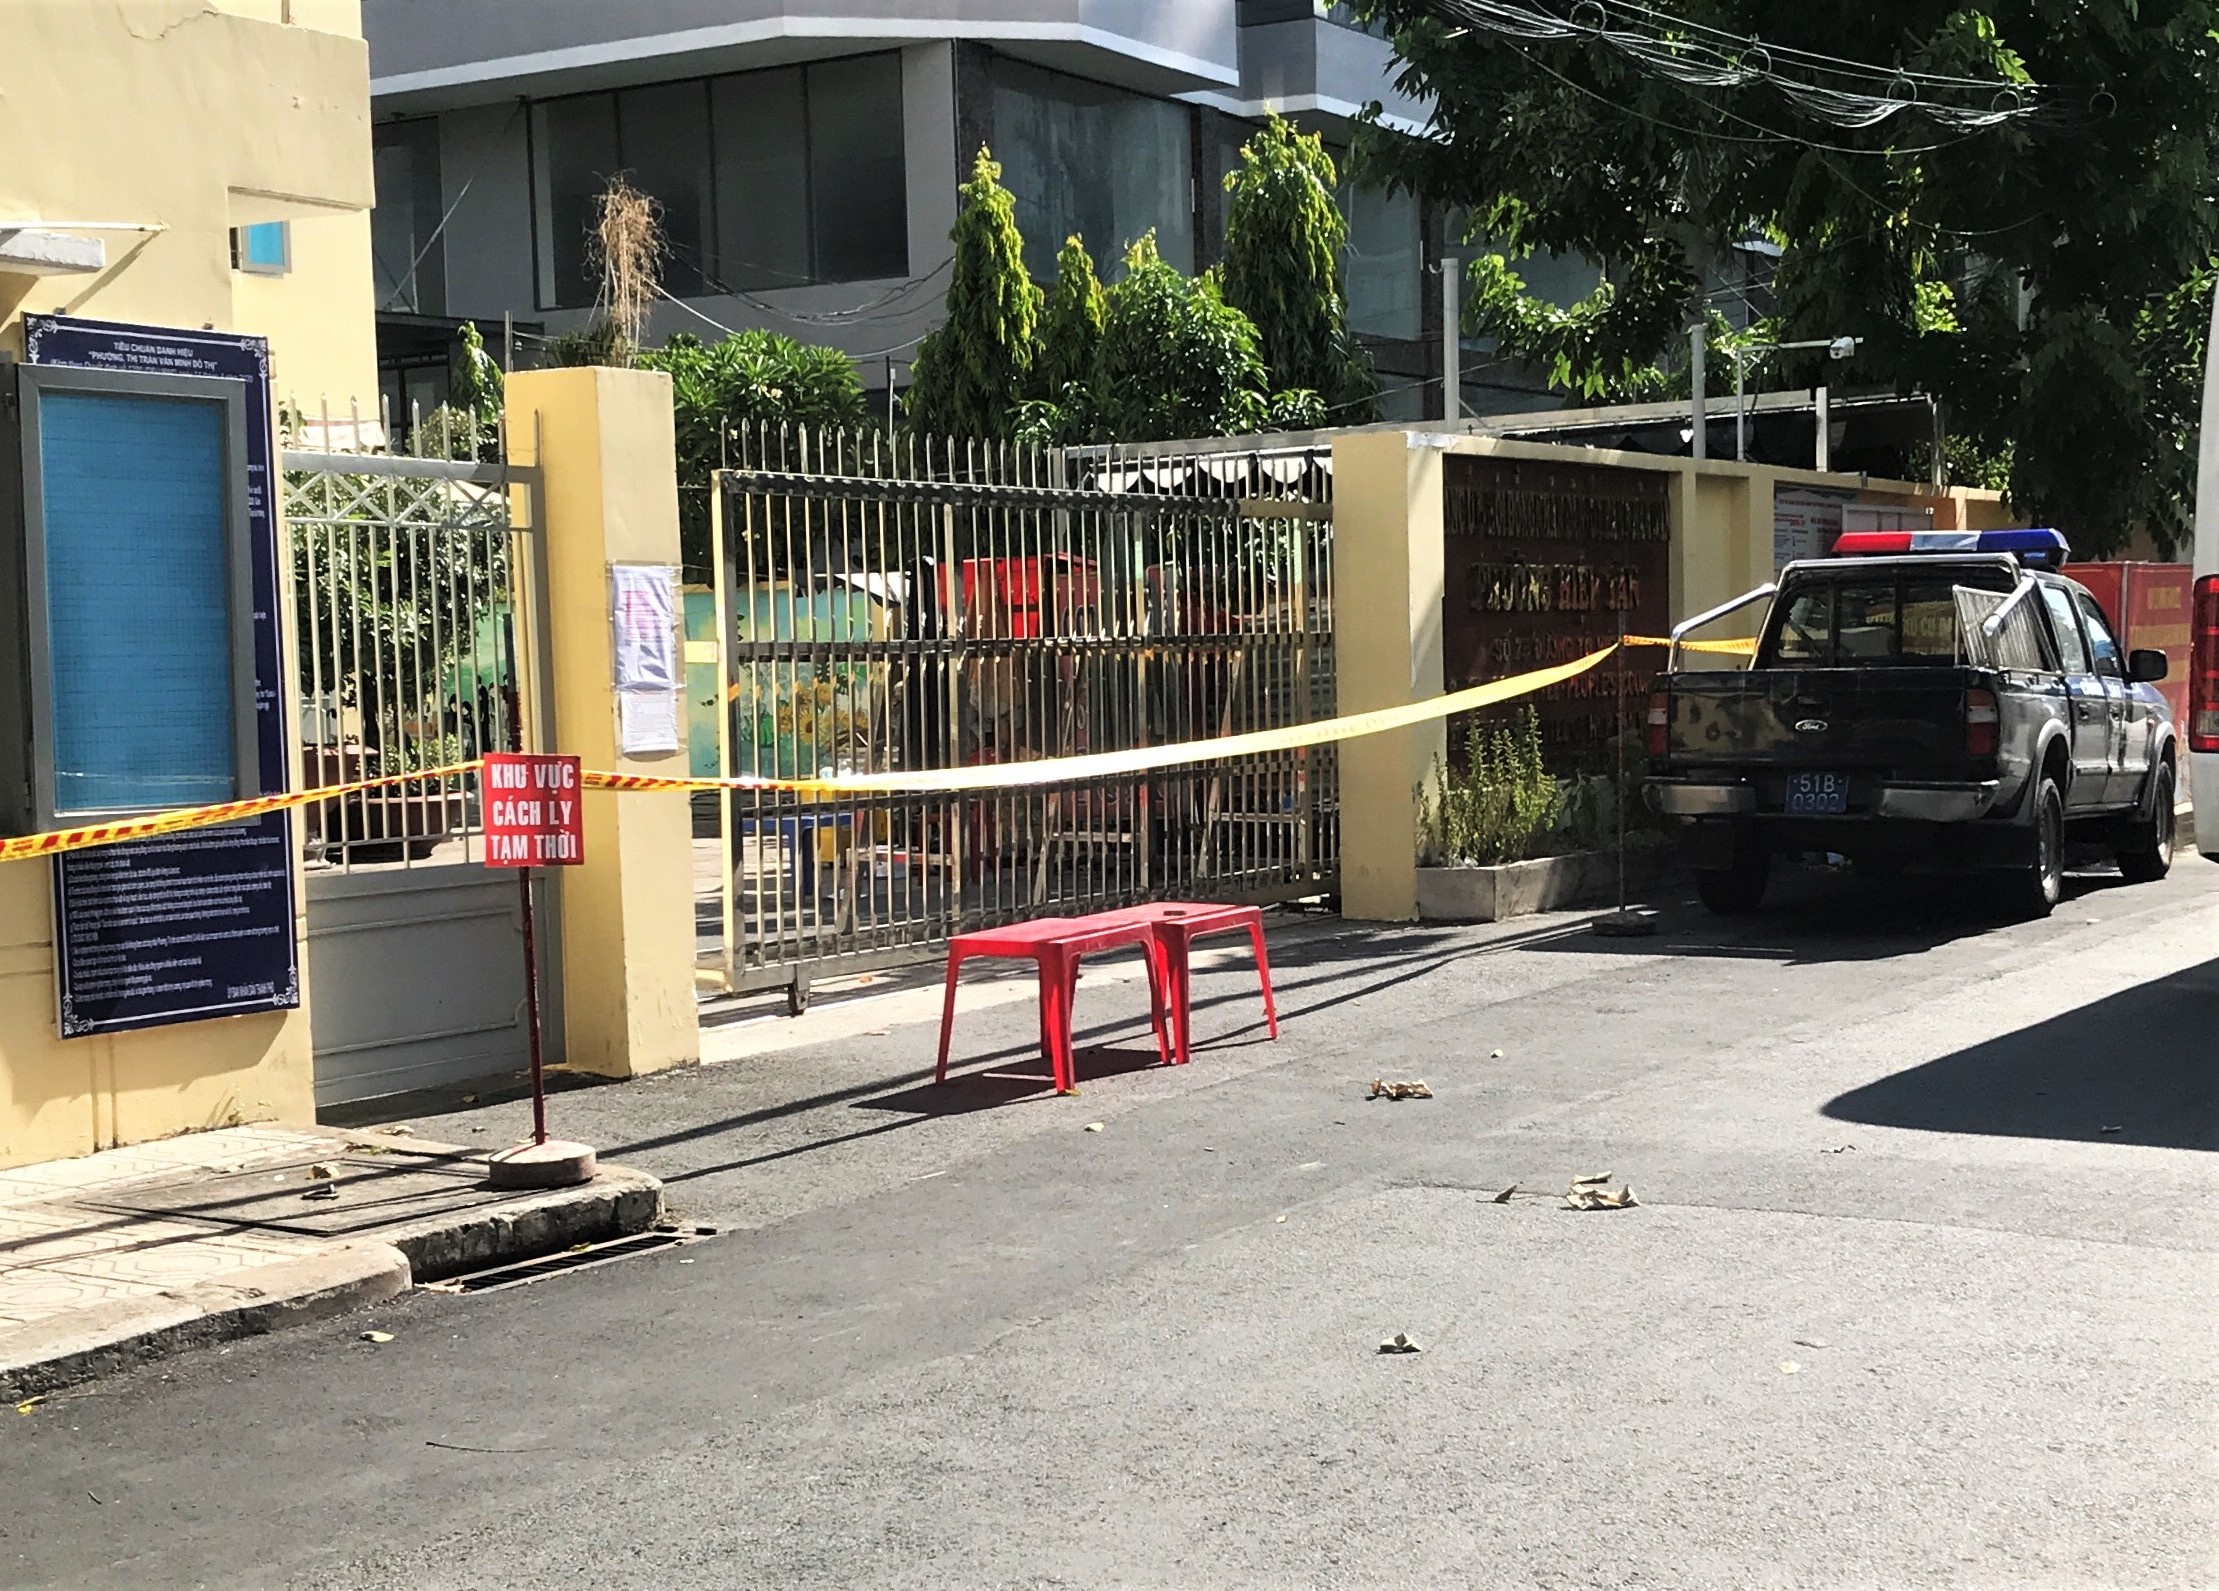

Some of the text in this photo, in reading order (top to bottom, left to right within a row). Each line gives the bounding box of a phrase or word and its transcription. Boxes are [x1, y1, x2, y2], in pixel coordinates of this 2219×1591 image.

[490, 761, 575, 795] KHU VỰC
[1800, 774, 1835, 793] 51B
[492, 796, 573, 826] CÁCH LY
[490, 829, 577, 865] TẠM THỜI
